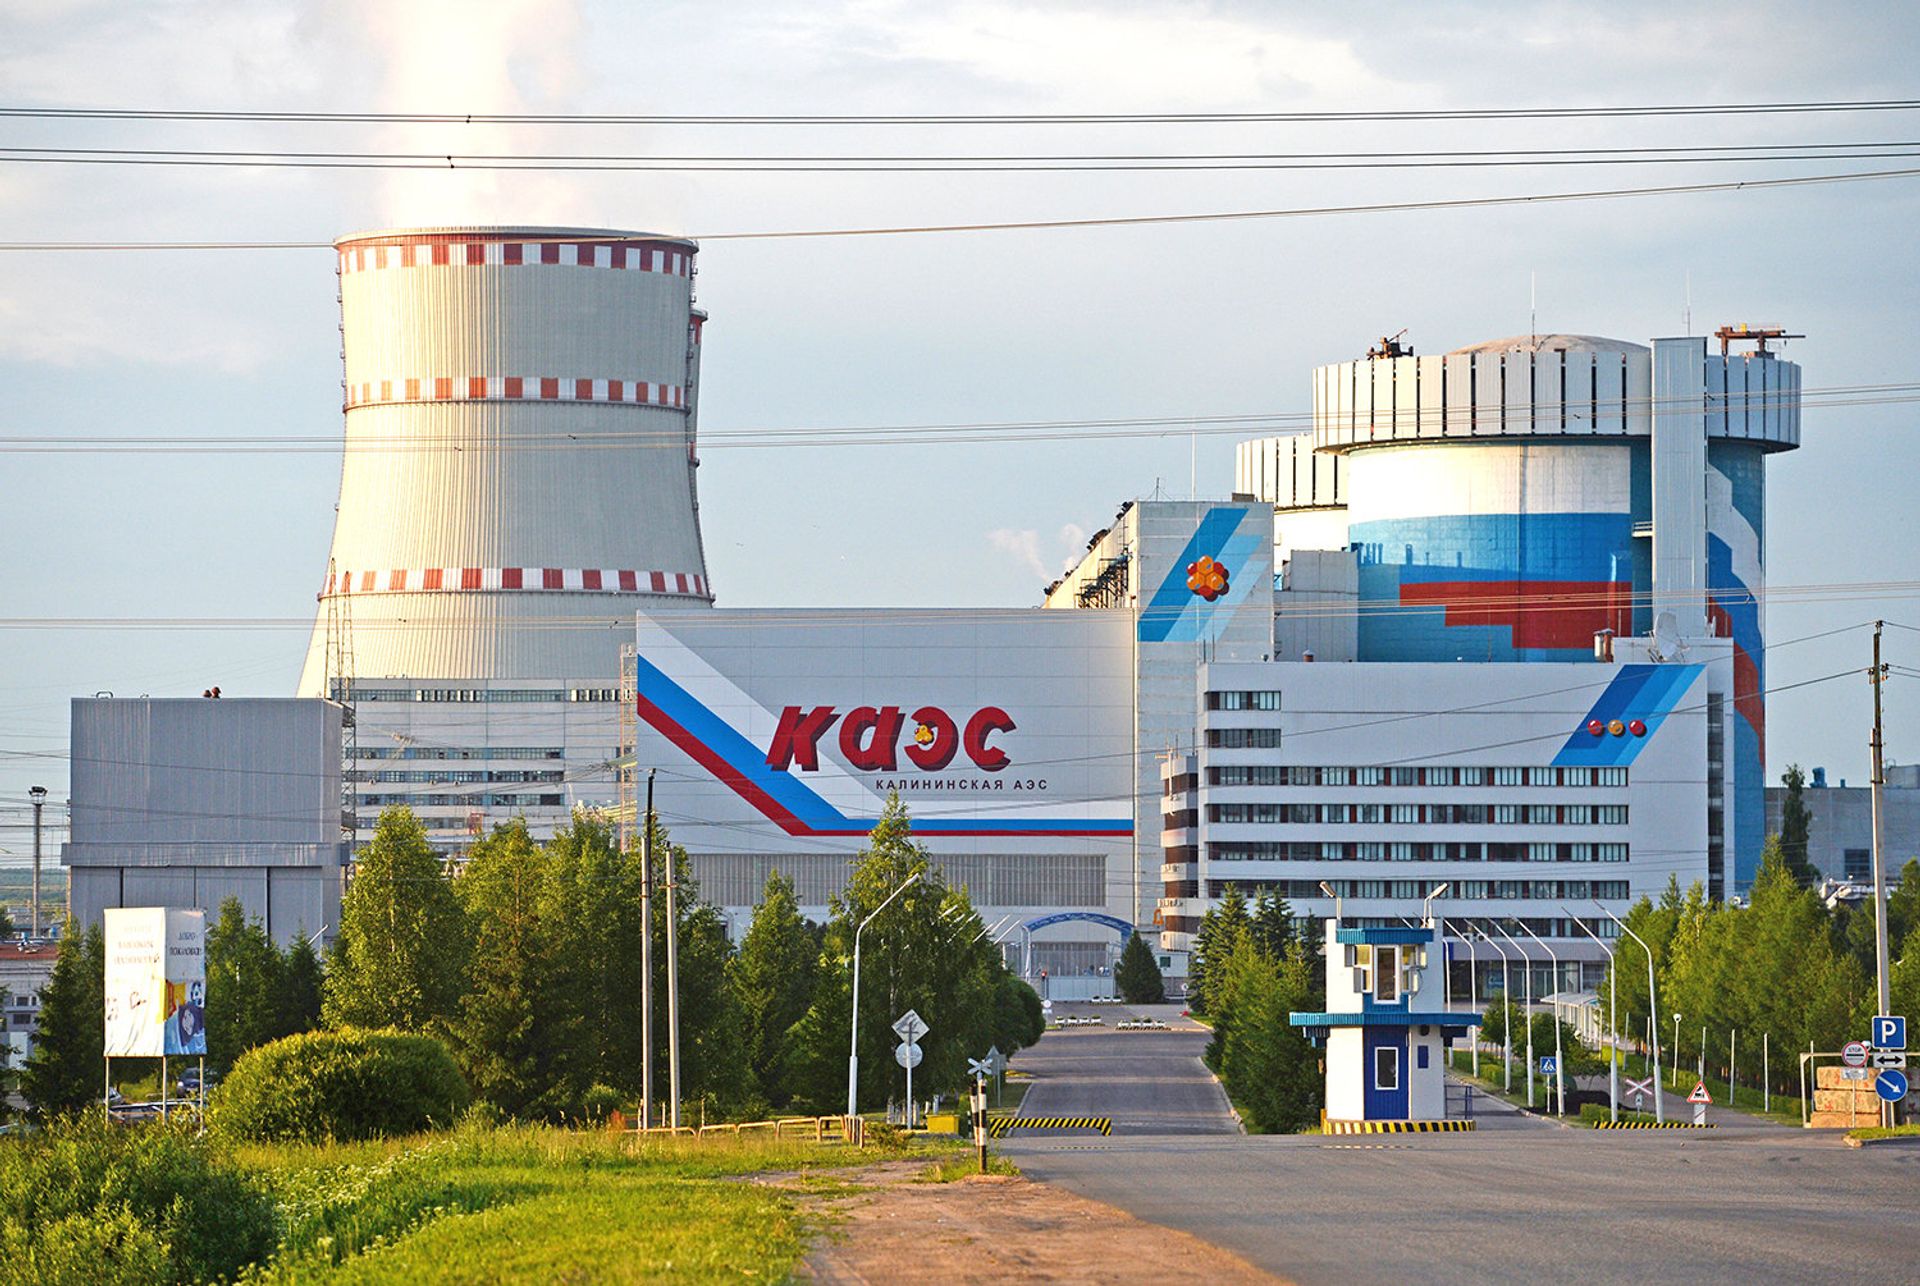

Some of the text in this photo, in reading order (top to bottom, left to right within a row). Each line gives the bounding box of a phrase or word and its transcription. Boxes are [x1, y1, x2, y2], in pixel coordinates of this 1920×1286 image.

[875, 779, 1049, 790] КАЛИНИНСКАЯ АЭС
[1882, 1020, 1897, 1044] P
